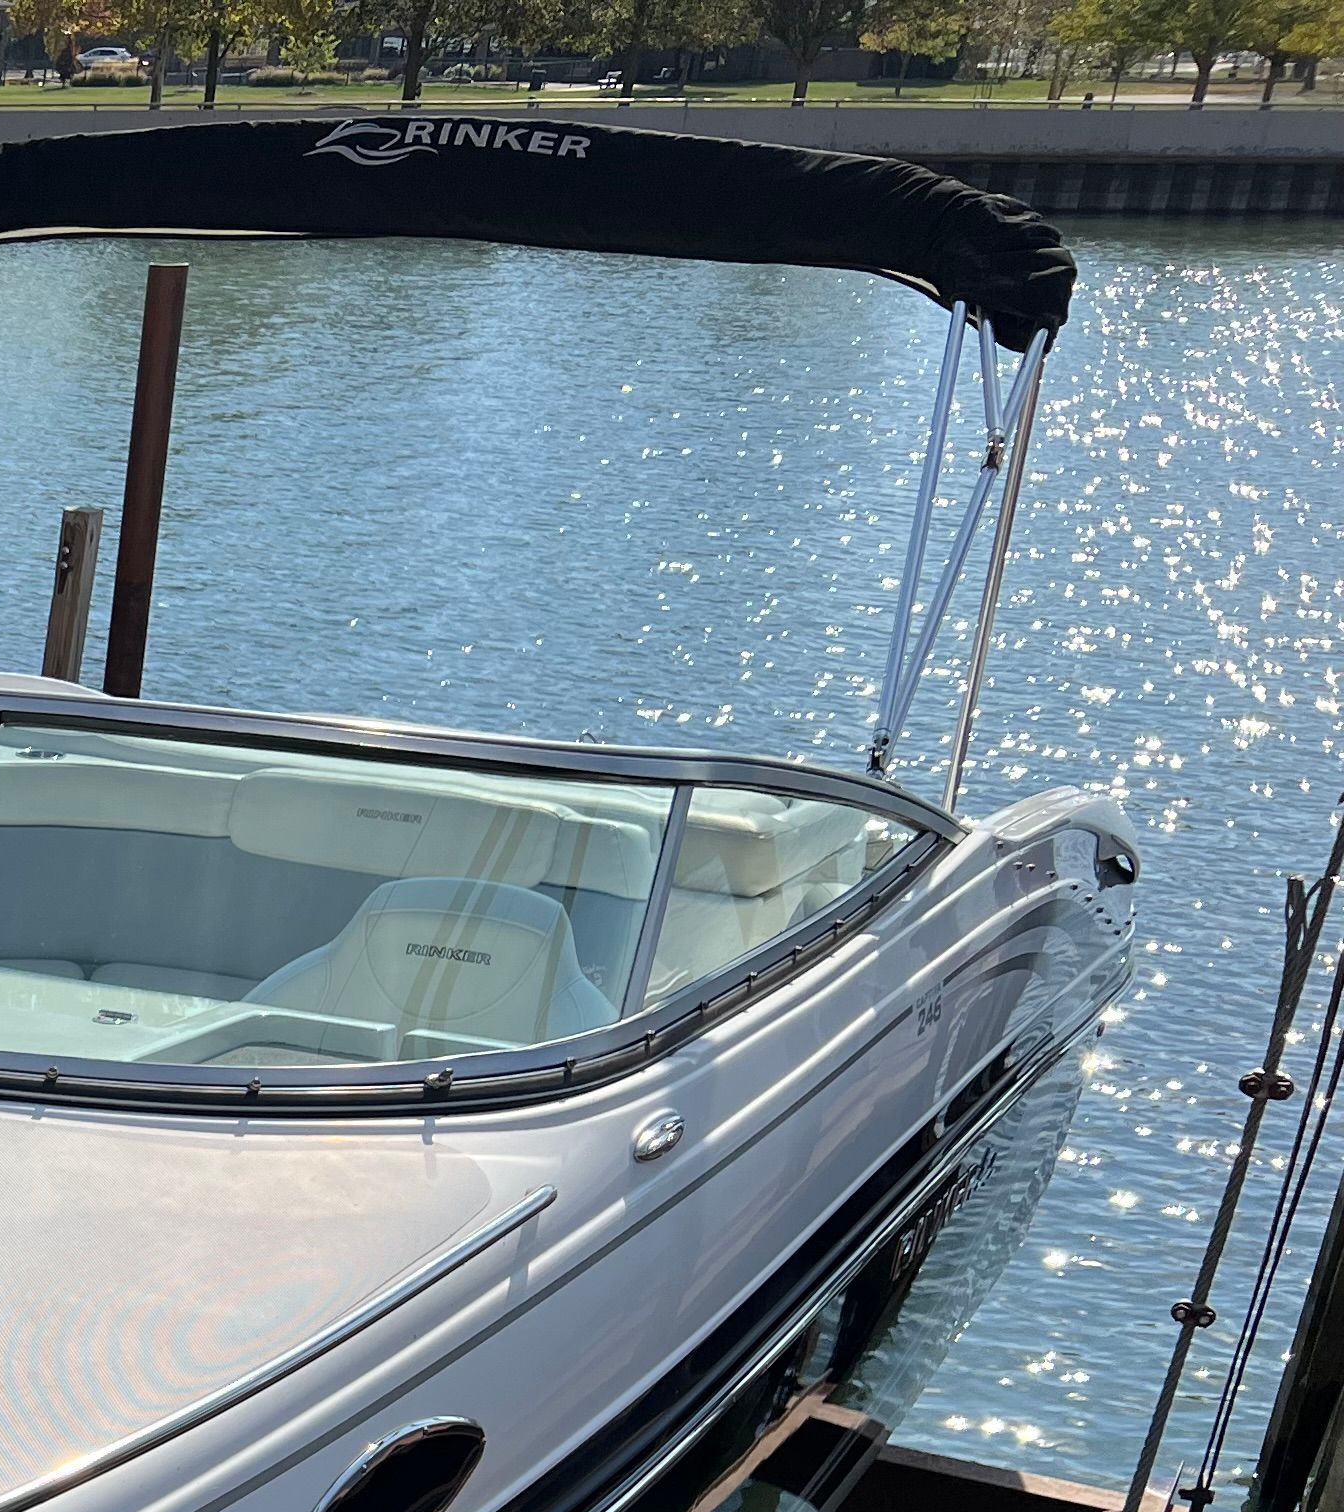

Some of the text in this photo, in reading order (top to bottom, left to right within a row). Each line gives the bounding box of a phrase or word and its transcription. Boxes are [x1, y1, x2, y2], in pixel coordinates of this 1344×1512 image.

[403, 120, 593, 159] RINKER
[406, 943, 492, 966] RINKER
[917, 995, 942, 1037] 246
